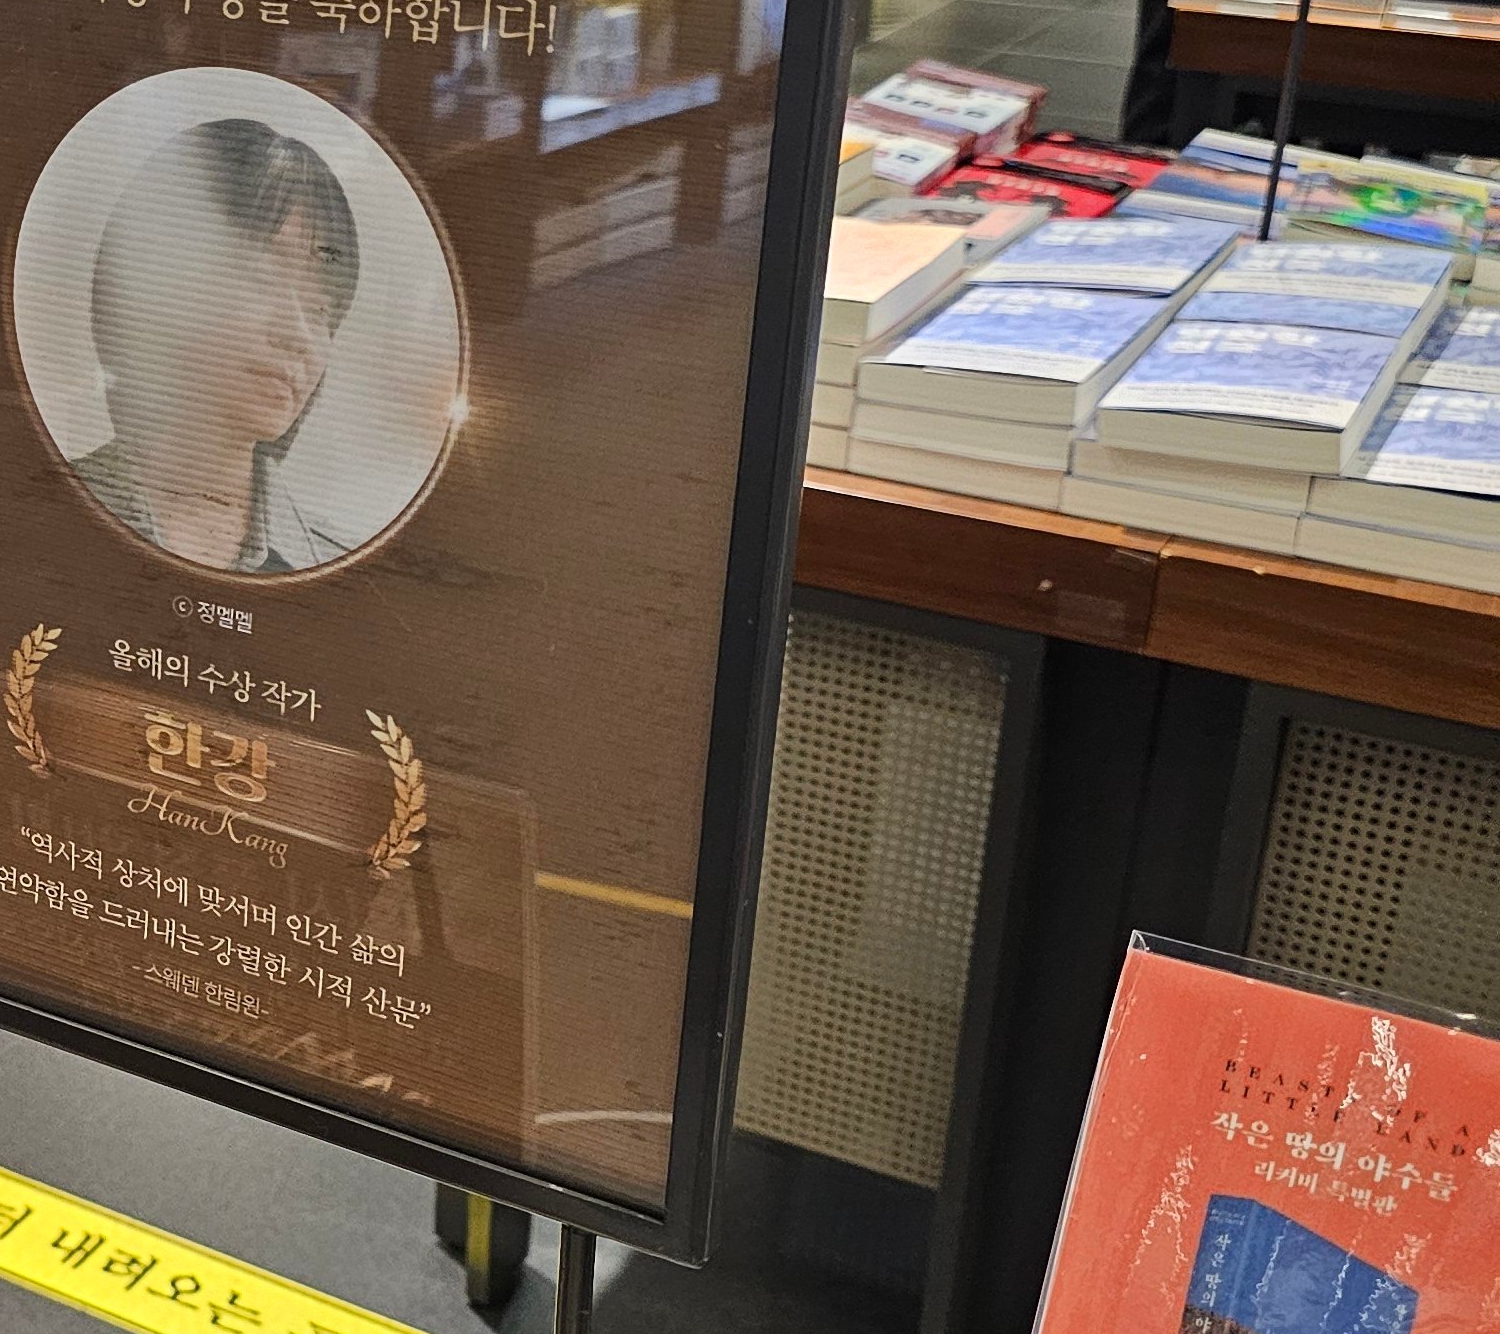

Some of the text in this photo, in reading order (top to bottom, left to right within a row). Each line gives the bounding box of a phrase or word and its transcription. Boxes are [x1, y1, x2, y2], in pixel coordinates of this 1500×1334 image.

[197, 601, 253, 635] 정멜멜
[108, 638, 323, 723] 올해의 수상 작가
[145, 710, 277, 803] 한강
[98, 899, 205, 956] 드러내는
[208, 935, 293, 986] 강렬한
[298, 966, 353, 1009] 시적
[111, 858, 188, 908] 상처에
[197, 884, 277, 936] 맞서며
[285, 914, 343, 956] 인간
[348, 933, 405, 978] 삶의
[1225, 1059, 1358, 1106] BEAST
[1210, 1110, 1459, 1204] 작은 땅의 야수들
[1253, 1160, 1320, 1196] 리커버
[1374, 1121, 1467, 1158] LAND
